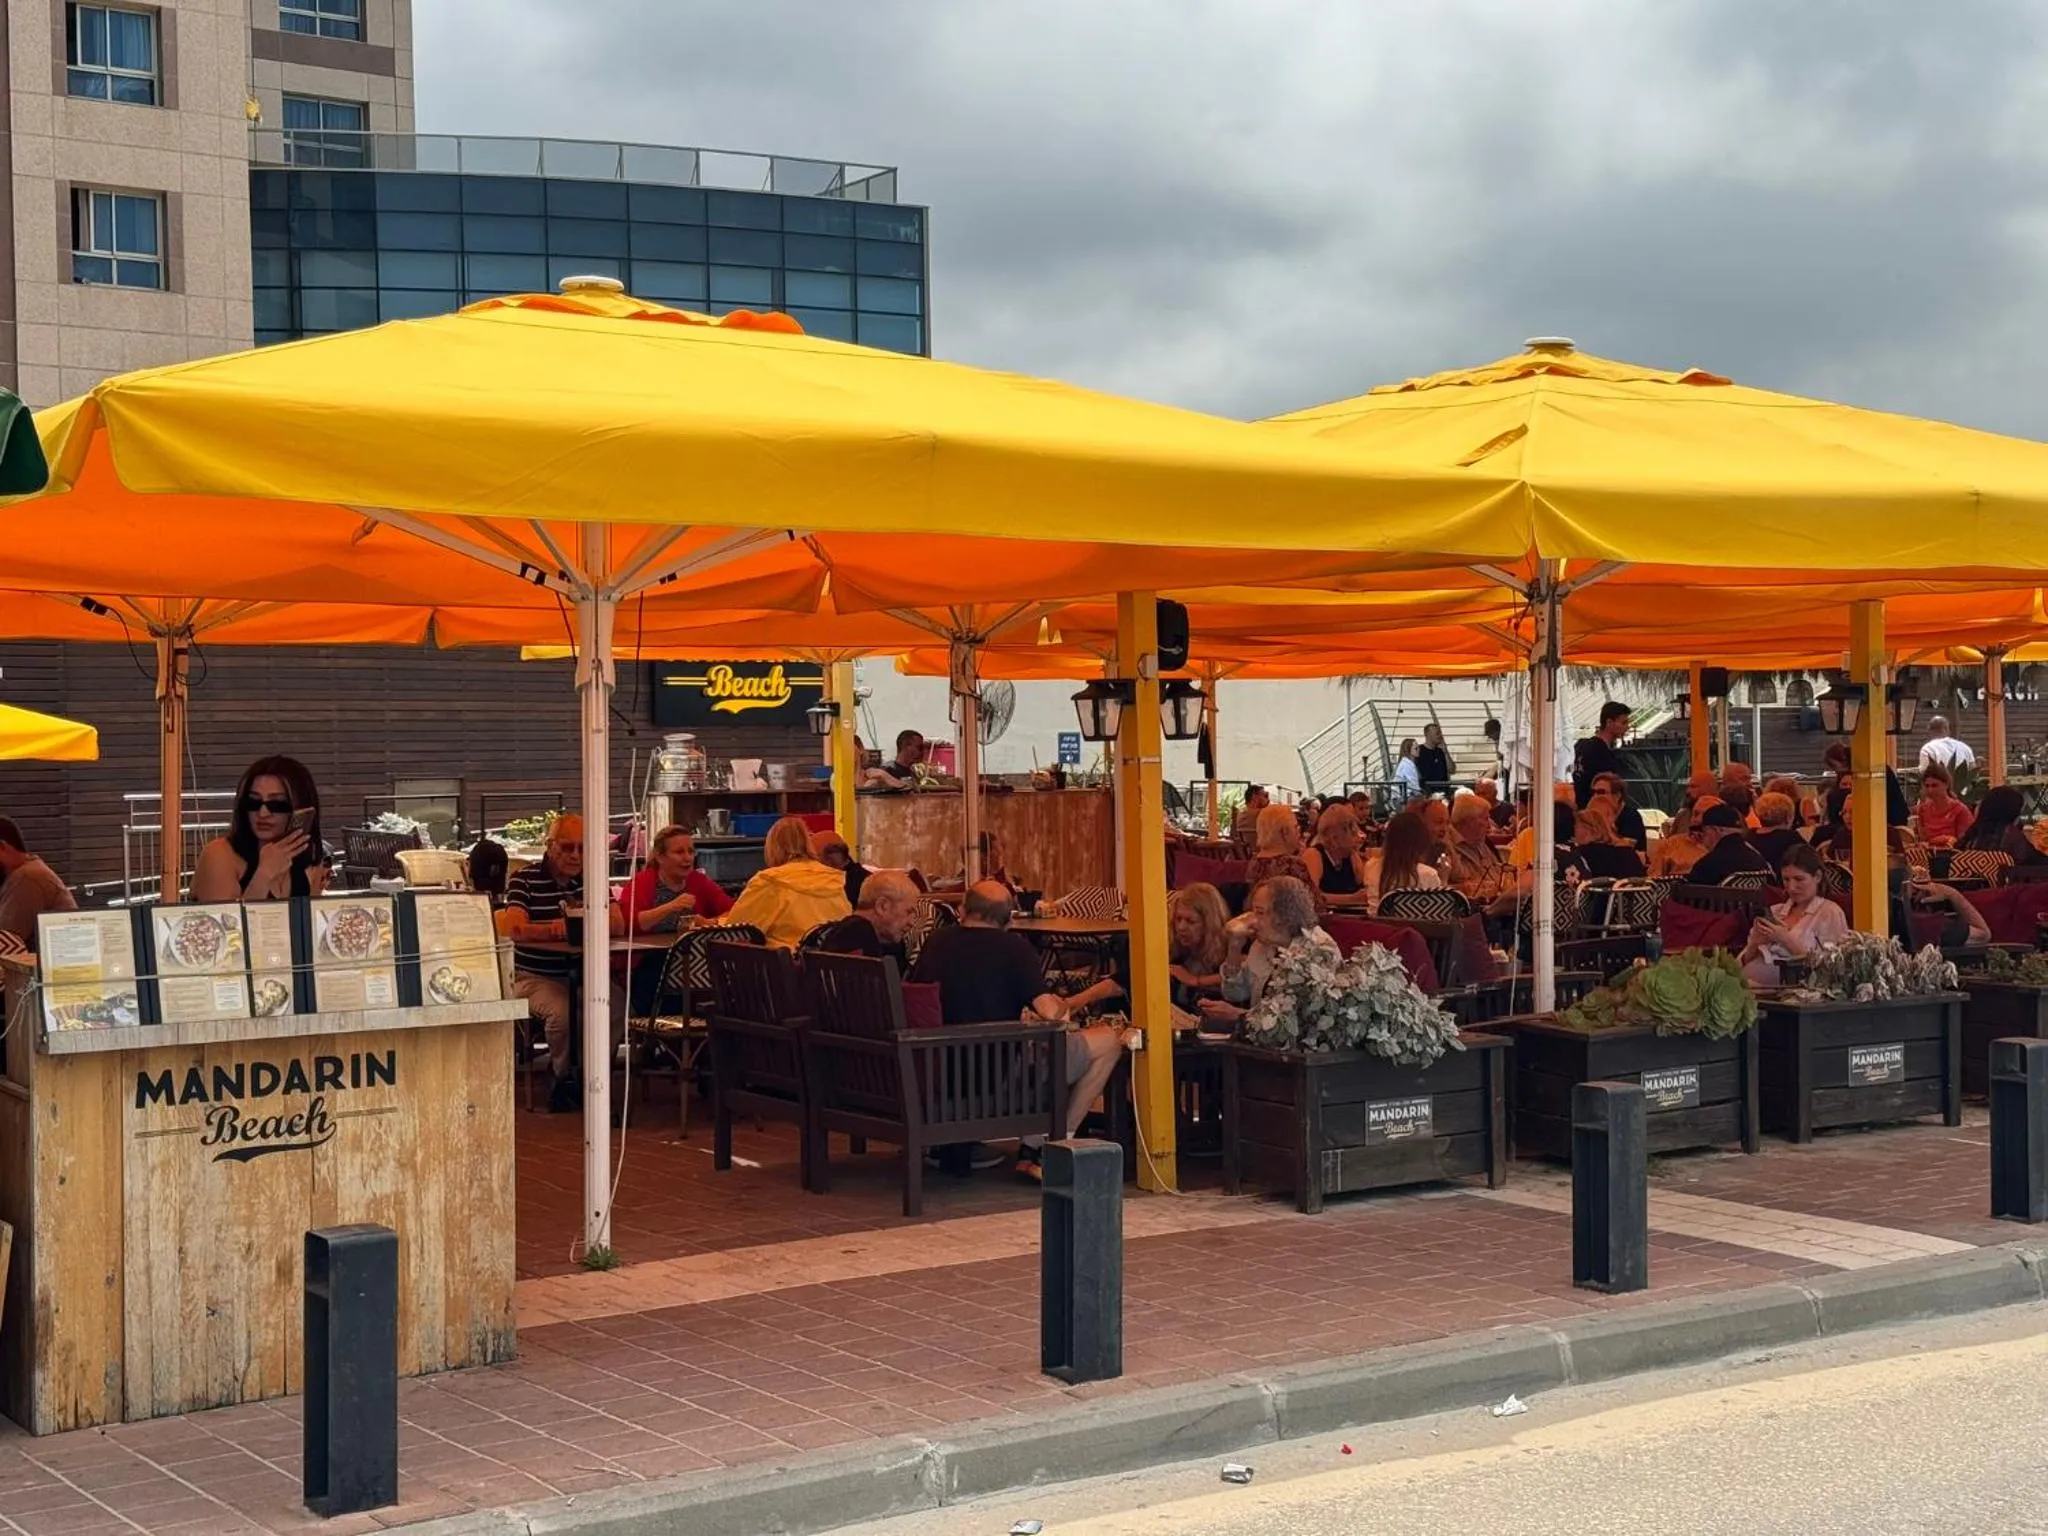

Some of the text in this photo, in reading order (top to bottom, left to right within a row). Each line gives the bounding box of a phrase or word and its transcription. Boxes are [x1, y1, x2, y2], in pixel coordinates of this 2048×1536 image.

[703, 664, 791, 703] Beach
[1850, 1050, 1901, 1066] MANDARIN
[135, 1050, 396, 1109] MANDARIN
[1644, 1073, 1697, 1091] MANDARIN
[1369, 1104, 1429, 1122] MANDARIN
[201, 1096, 337, 1149] Beach
[1383, 1119, 1416, 1135] Beach
